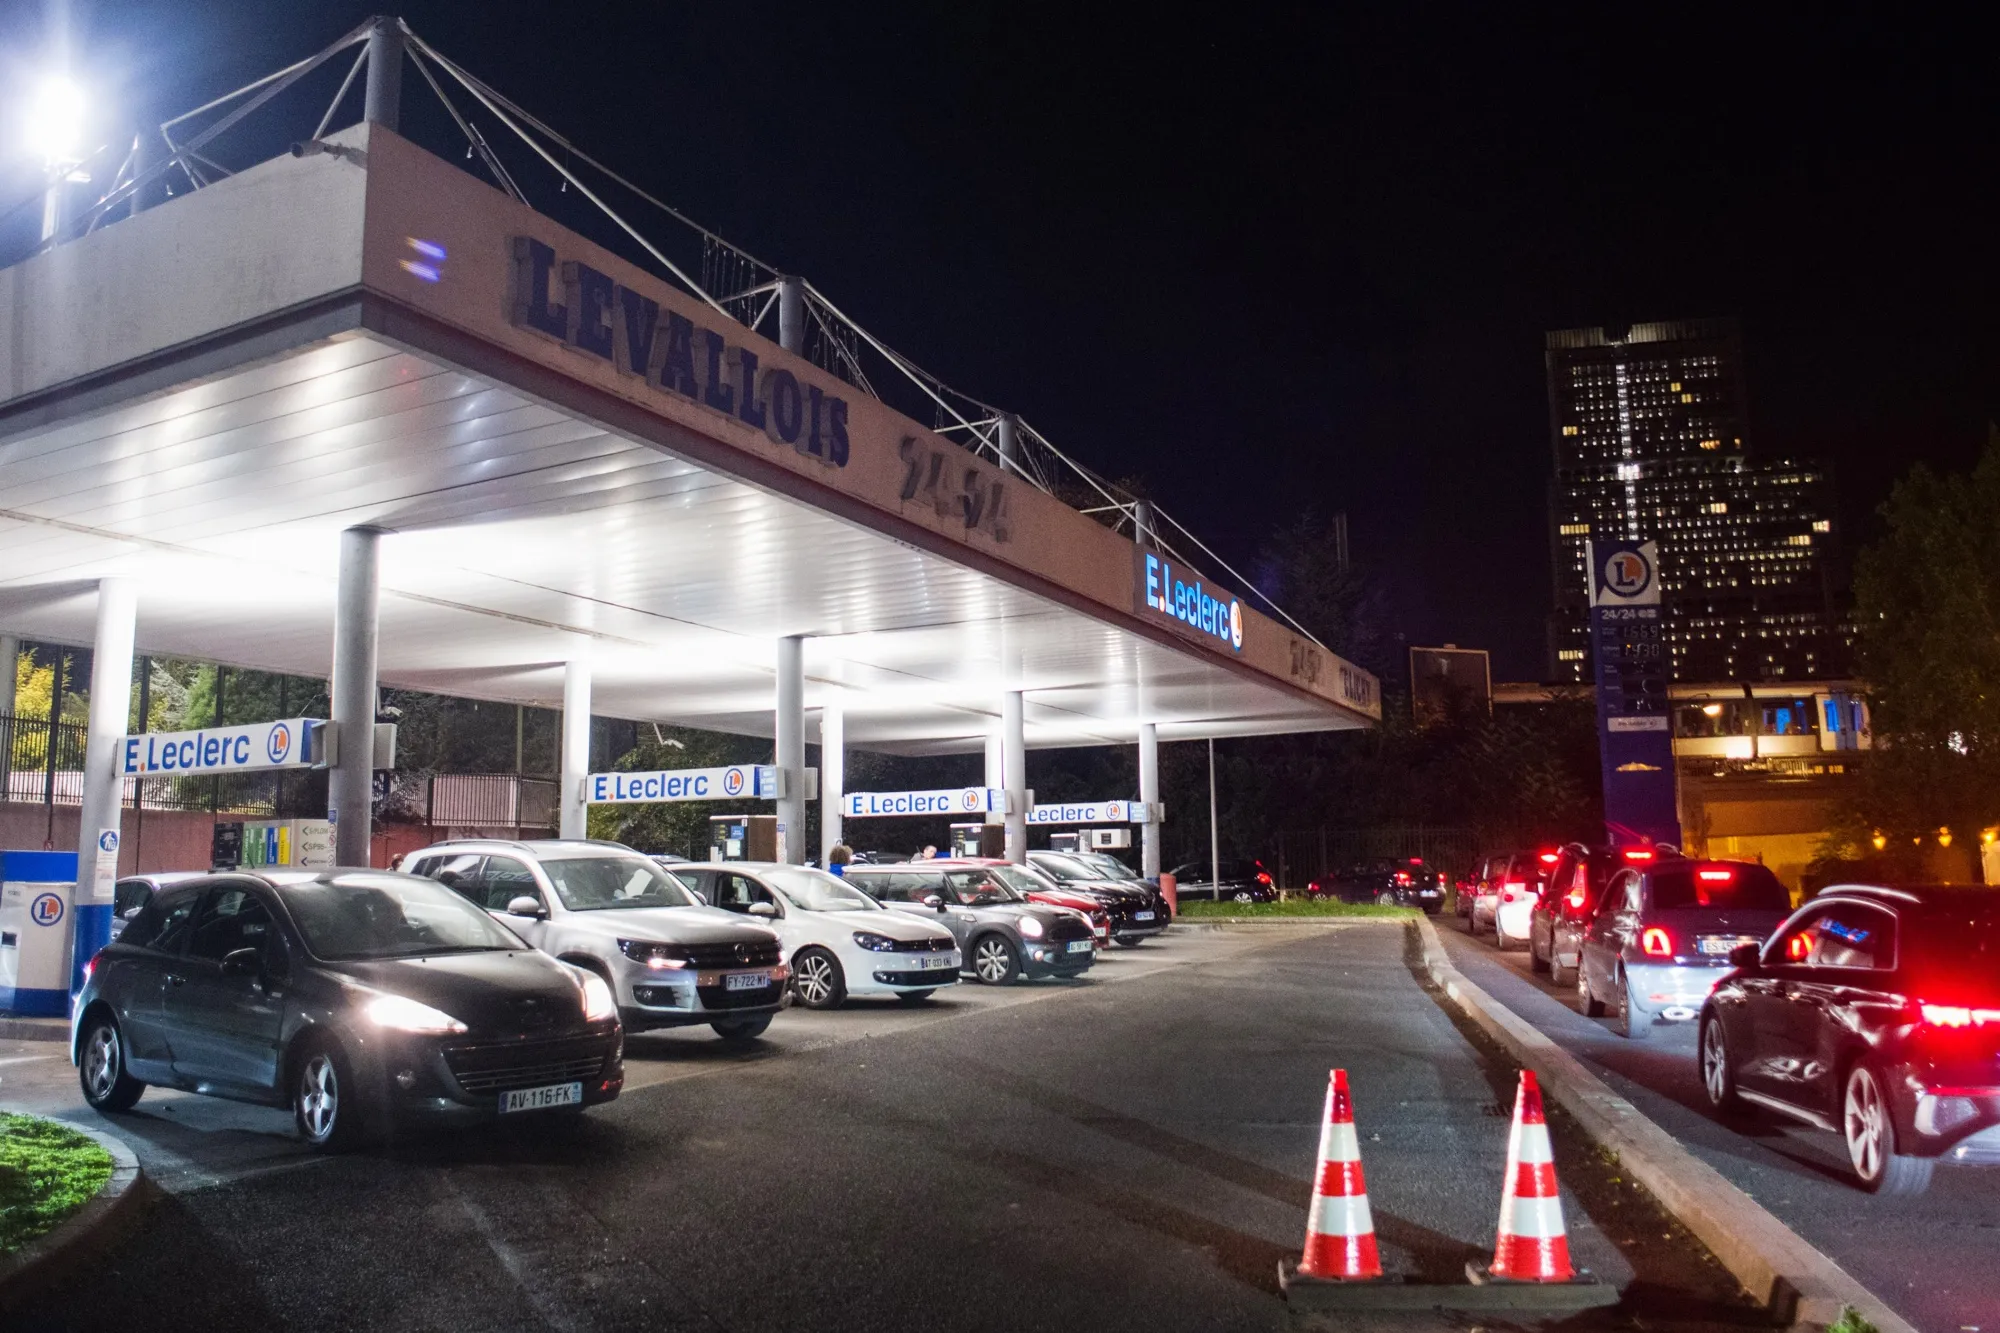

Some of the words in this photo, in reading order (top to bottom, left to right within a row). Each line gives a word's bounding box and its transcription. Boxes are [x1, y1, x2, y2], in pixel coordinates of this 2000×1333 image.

[513, 236, 850, 469] LEVALLOIS
[1145, 553, 1229, 641] E.Leclerc
[1601, 609, 1637, 620] 24/24
[124, 733, 250, 773] E.Leclerc
[595, 773, 709, 801] E.Leclerc
[852, 794, 949, 814] E.Leclerc
[510, 1087, 571, 1109] AV-116-FK
